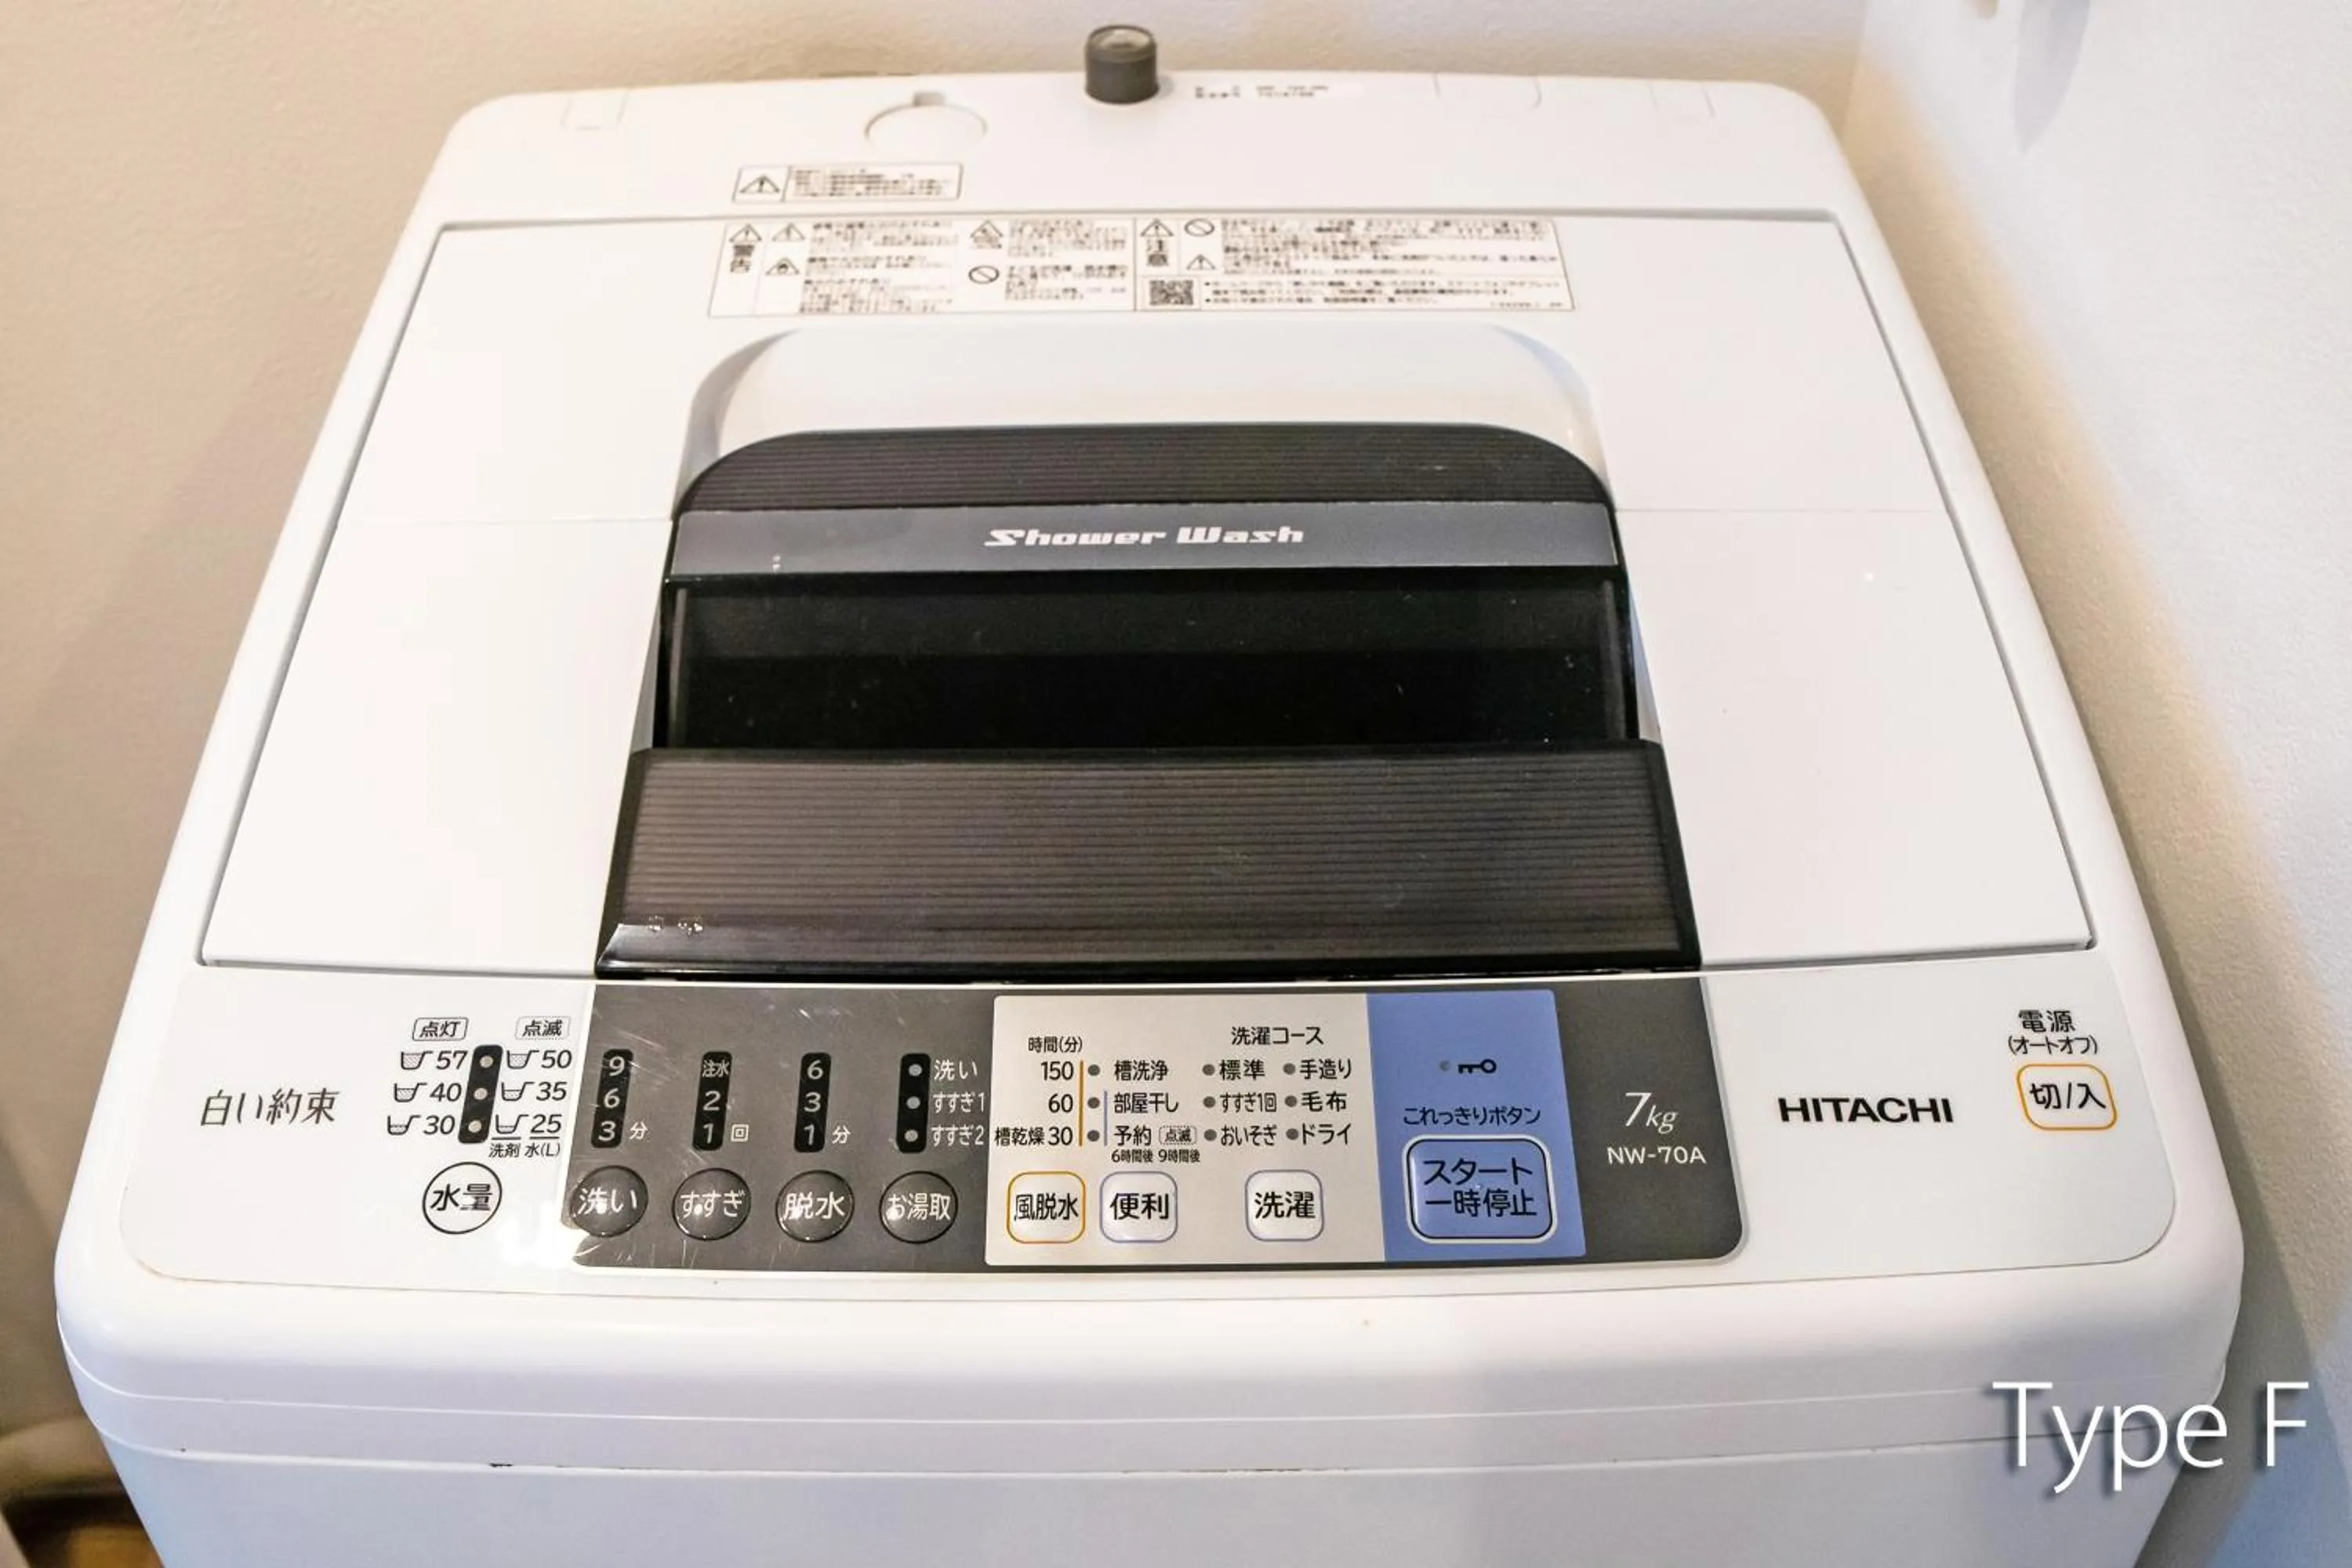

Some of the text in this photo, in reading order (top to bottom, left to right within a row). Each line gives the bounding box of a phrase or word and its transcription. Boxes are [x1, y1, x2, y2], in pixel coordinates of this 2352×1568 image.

[984, 526, 1304, 547] Shower Wash
[419, 1022, 461, 1038] 点灯
[522, 1019, 563, 1037] 点滅
[2019, 1010, 2074, 1033] 電源
[1029, 1036, 1083, 1054] 時間(分)
[1232, 1026, 1323, 1046] 洗濯コース
[2009, 1035, 2098, 1055] (オートオフ)
[436, 1050, 468, 1069] 57
[541, 1050, 572, 1069] 50
[609, 1057, 626, 1076] 9
[702, 1060, 731, 1077] 注水
[1219, 1059, 1265, 1080] 標準
[1299, 1059, 1352, 1080] 手造り
[807, 1060, 823, 1080] 6
[934, 1059, 978, 1081] 洗い
[1040, 1061, 1074, 1081] 150
[1114, 1060, 1168, 1081] 槽洗浄
[430, 1083, 462, 1102] 40
[537, 1082, 567, 1101] 35
[604, 1089, 620, 1109] 6
[702, 1091, 720, 1111] 2
[1220, 1091, 1277, 1112] すすぎ1回
[1301, 1091, 1348, 1112] 毛布
[2030, 1081, 2107, 1110] 切/入
[201, 1088, 340, 1127] 白い約束
[804, 1093, 821, 1112] 3
[1048, 1094, 1073, 1113] 60
[1113, 1092, 1179, 1114] 部屋干し
[1778, 1097, 1954, 1123] HITACHI
[423, 1115, 456, 1135] 30
[531, 1114, 562, 1134] 25
[1403, 1106, 1541, 1126] これっきりボタン
[598, 1122, 648, 1142] 3 分
[702, 1123, 749, 1143] 1 回
[804, 1125, 851, 1145] 1 分
[994, 1126, 1073, 1146] 槽乾燥 30
[1113, 1125, 1152, 1146] 予約
[1220, 1123, 1277, 1146] おいそぎ
[1301, 1123, 1352, 1145] ドライ
[488, 1142, 561, 1158] 洗剤 水(L)
[1111, 1149, 1200, 1163] 6時間後 9時間後
[1607, 1145, 1707, 1165] NW-70A
[1423, 1157, 1534, 1186] スタート
[430, 1183, 493, 1212] 水量
[577, 1188, 638, 1214] 洗い
[680, 1190, 746, 1218] すすぎ
[783, 1192, 846, 1220] 脱水
[887, 1192, 952, 1221] お湯取
[1014, 1192, 1079, 1221] 風脱水
[1109, 1192, 1170, 1221] 便利
[1254, 1191, 1316, 1220] 洗濯
[1425, 1188, 1537, 1218] 一時停止
